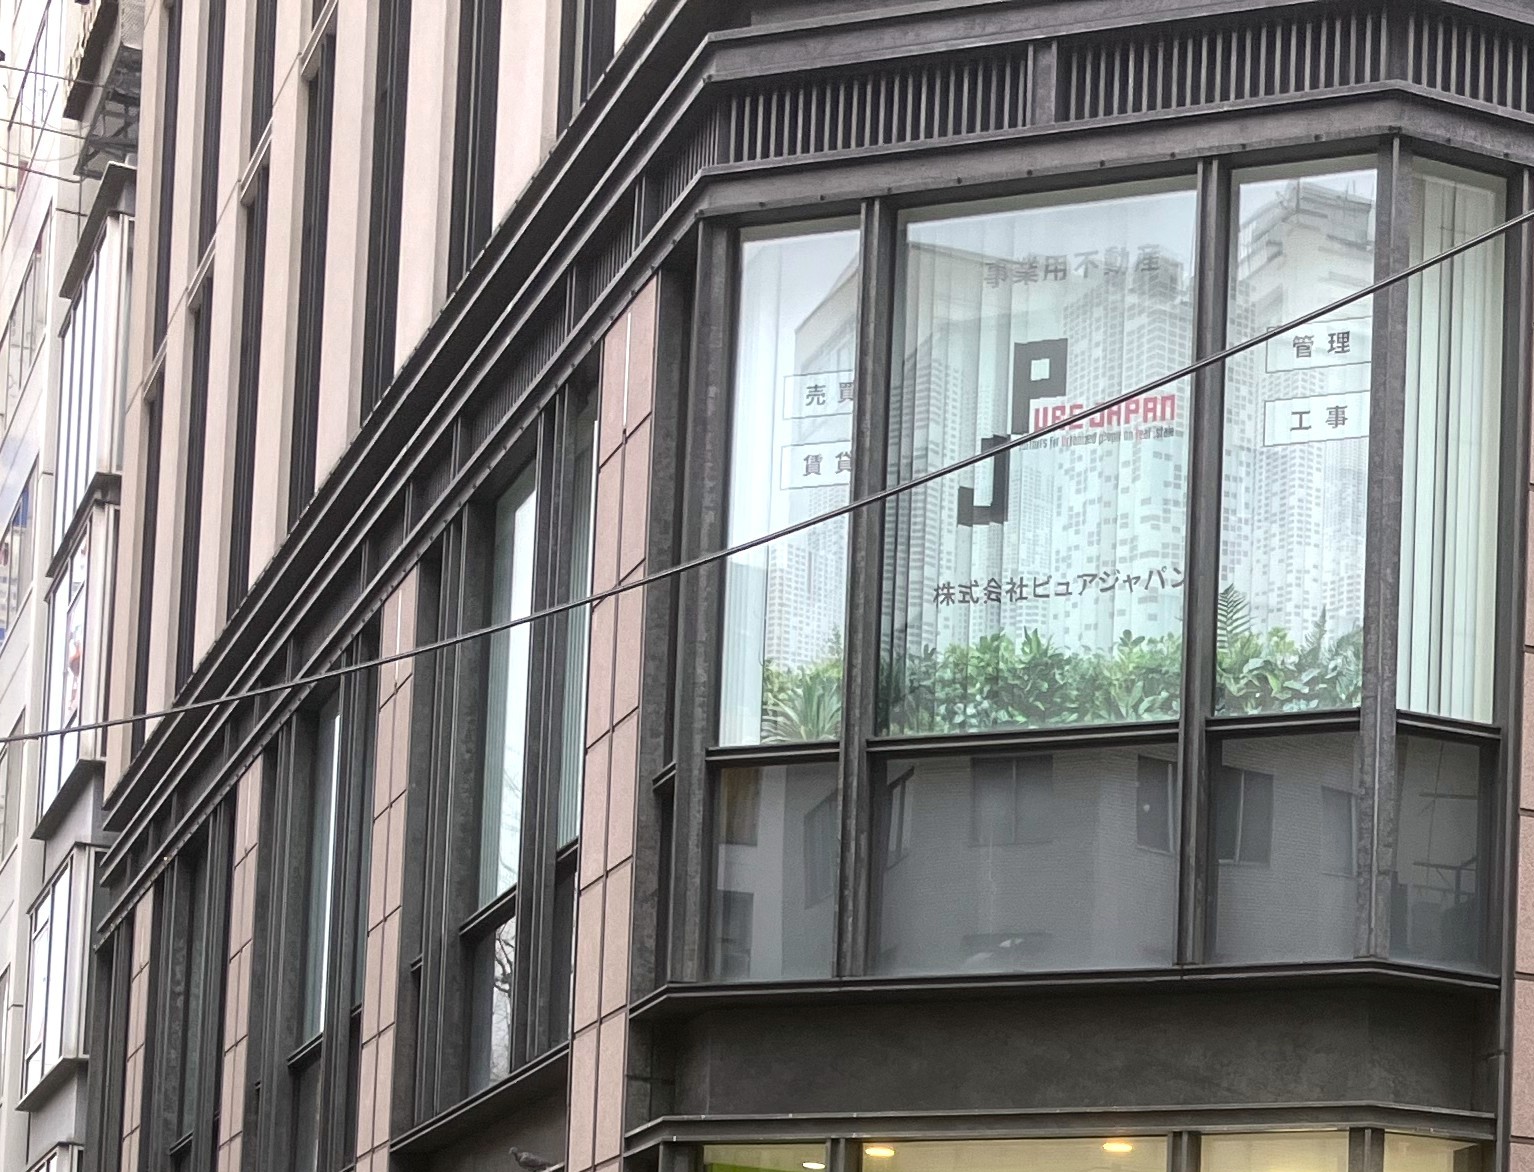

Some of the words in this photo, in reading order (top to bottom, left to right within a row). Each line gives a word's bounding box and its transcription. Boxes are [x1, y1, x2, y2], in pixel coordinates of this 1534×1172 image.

[985, 244, 1161, 288] 事業用不動産
[1293, 331, 1351, 359] 管理
[805, 382, 854, 406] 売買
[1089, 394, 1176, 430] JAPAN
[1290, 405, 1348, 432] 工事
[933, 566, 1184, 607] 株式会社ピュアジャパン
